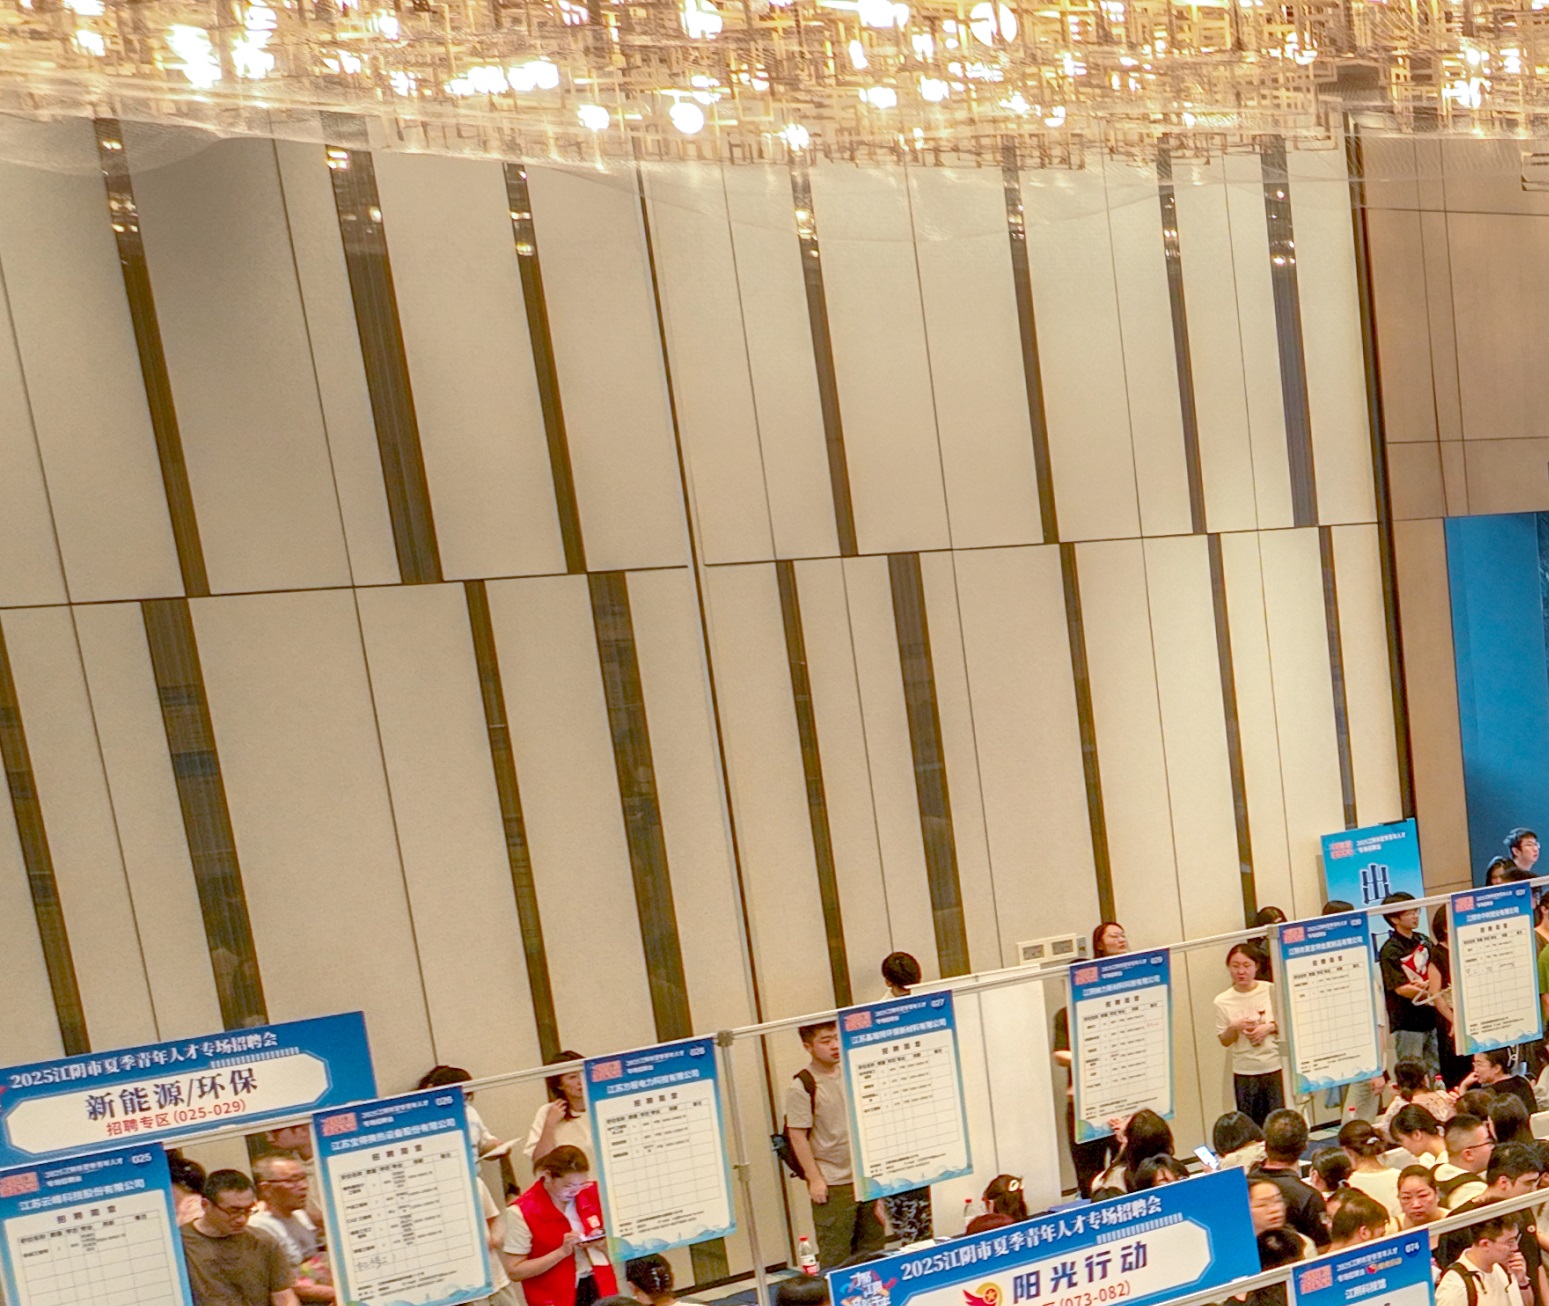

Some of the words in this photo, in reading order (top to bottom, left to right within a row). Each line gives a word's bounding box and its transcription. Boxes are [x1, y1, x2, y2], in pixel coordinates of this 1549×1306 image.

[10, 1032, 278, 1089] 2025江阴市夏季青年人才专场招聘会
[84, 1067, 258, 1121] 新能源/环保
[131, 1152, 151, 1164] 025
[901, 1196, 1162, 1281] 2025江阴市夏季青年人才专场招聘会
[1404, 1240, 1420, 1254] 074
[1013, 1241, 1148, 1305] 阳光行动
